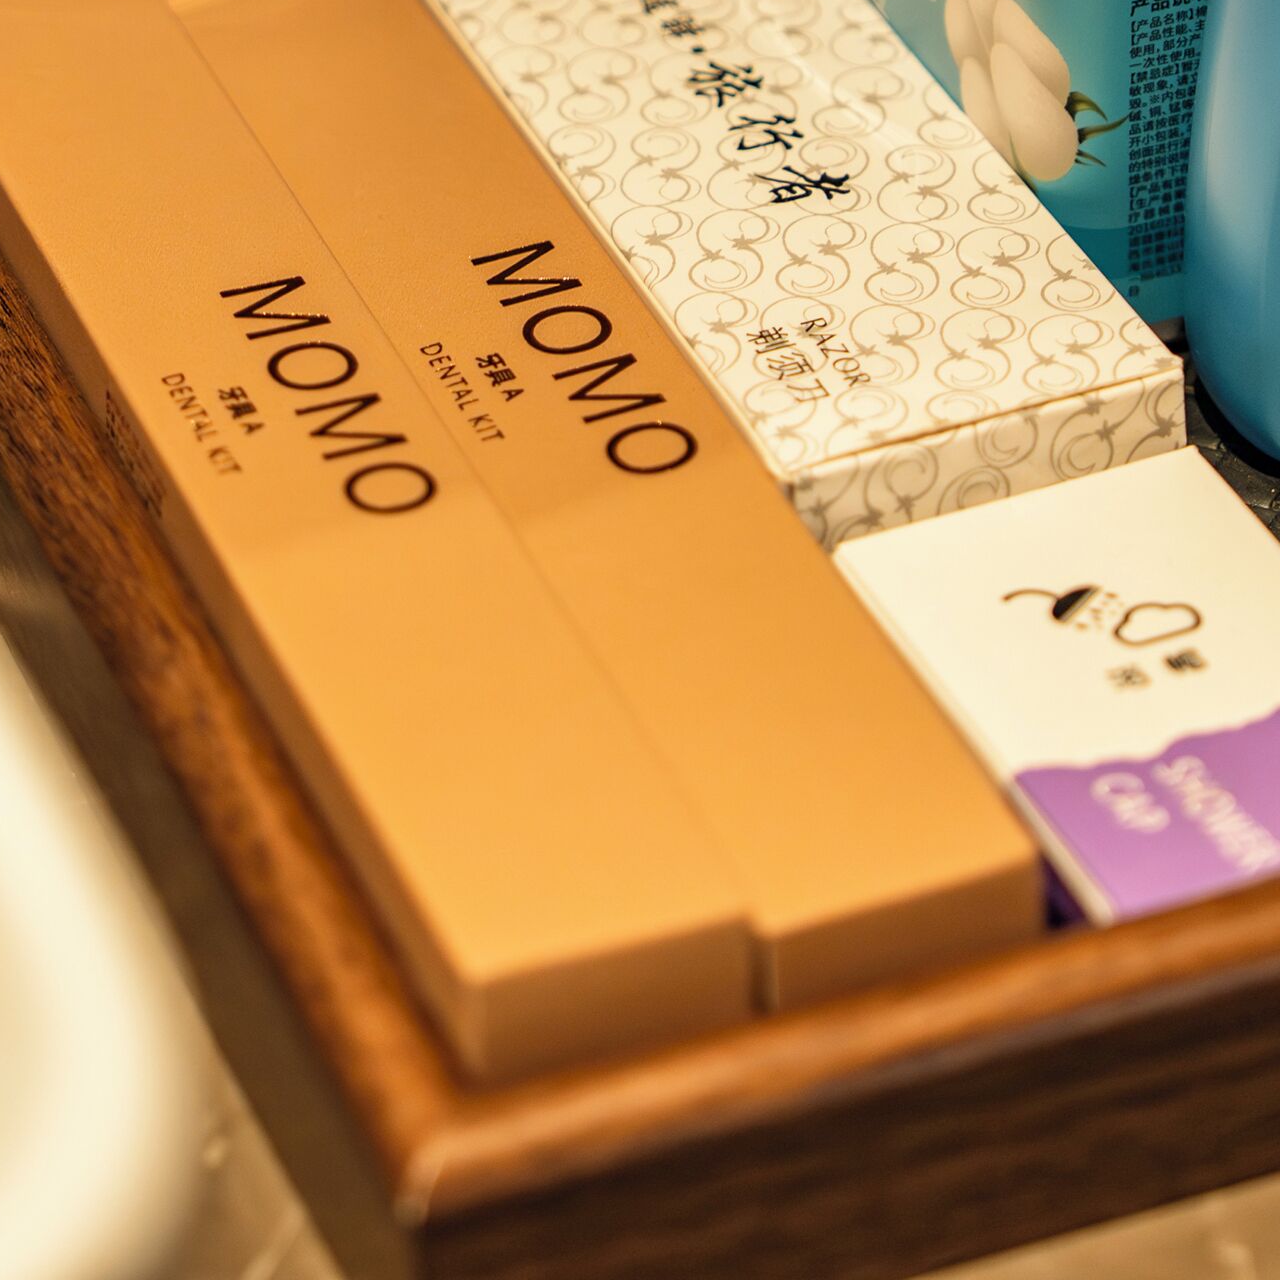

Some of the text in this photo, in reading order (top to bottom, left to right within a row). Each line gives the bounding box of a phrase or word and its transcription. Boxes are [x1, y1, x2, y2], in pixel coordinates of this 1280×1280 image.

[219, 275, 438, 515] MOMO
[420, 342, 505, 442] DENTAL KIT
[470, 240, 699, 476] MOMO
[746, 326, 831, 404] 剃须刀
[800, 317, 871, 388] RAZOR
[161, 372, 242, 475] DENTAL KIT
